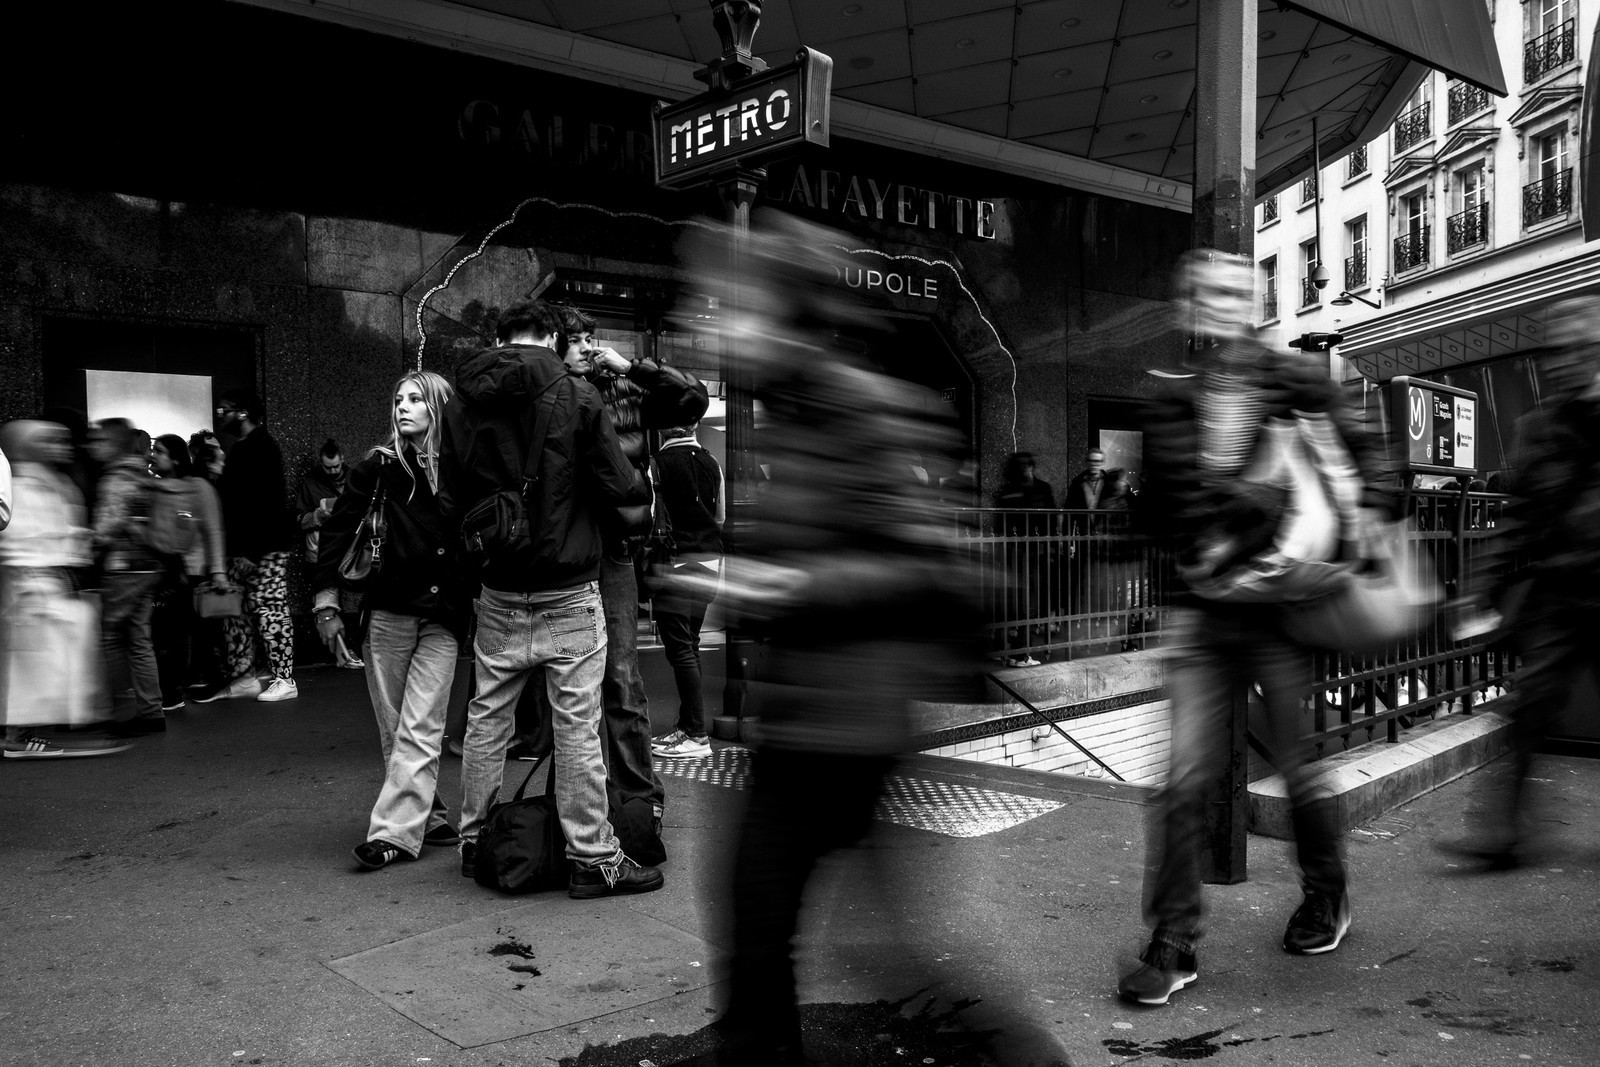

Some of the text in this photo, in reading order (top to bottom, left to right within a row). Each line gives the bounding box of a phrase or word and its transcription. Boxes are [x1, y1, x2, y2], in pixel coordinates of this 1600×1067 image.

[671, 89, 790, 163] METRO
[456, 98, 995, 240] GALER LAFAYETTE
[832, 265, 938, 299] UPOLE
